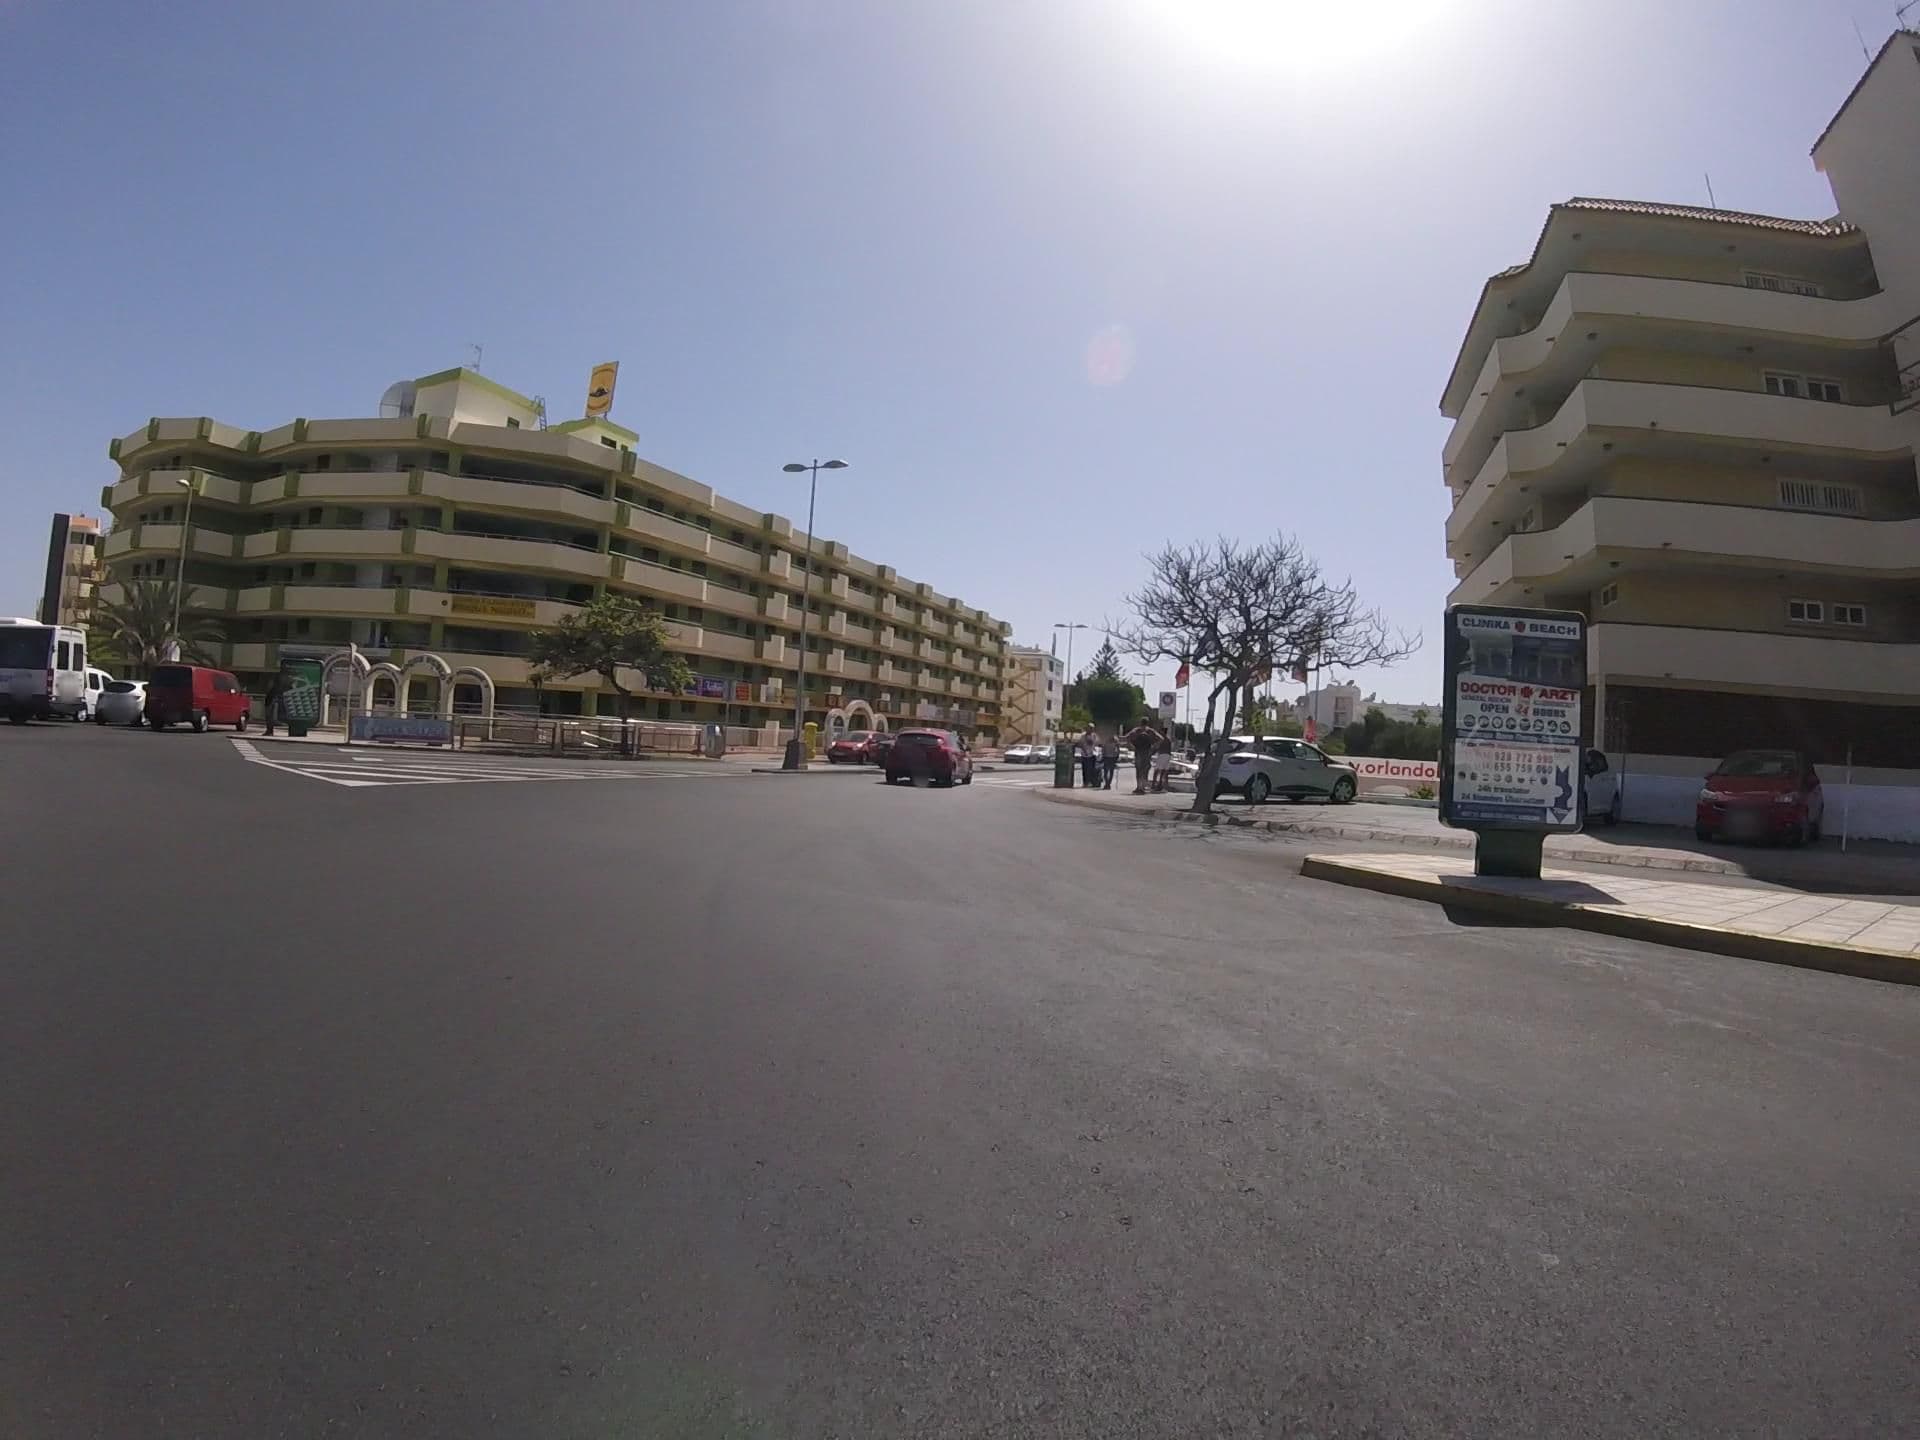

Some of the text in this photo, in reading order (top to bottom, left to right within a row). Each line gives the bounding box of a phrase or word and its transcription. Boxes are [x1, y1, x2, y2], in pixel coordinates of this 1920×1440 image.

[1462, 617, 1578, 636] CLINIKA BEACH
[1460, 682, 1578, 702] DOCTOR ARZT
[1480, 703, 1509, 713] OPEN
